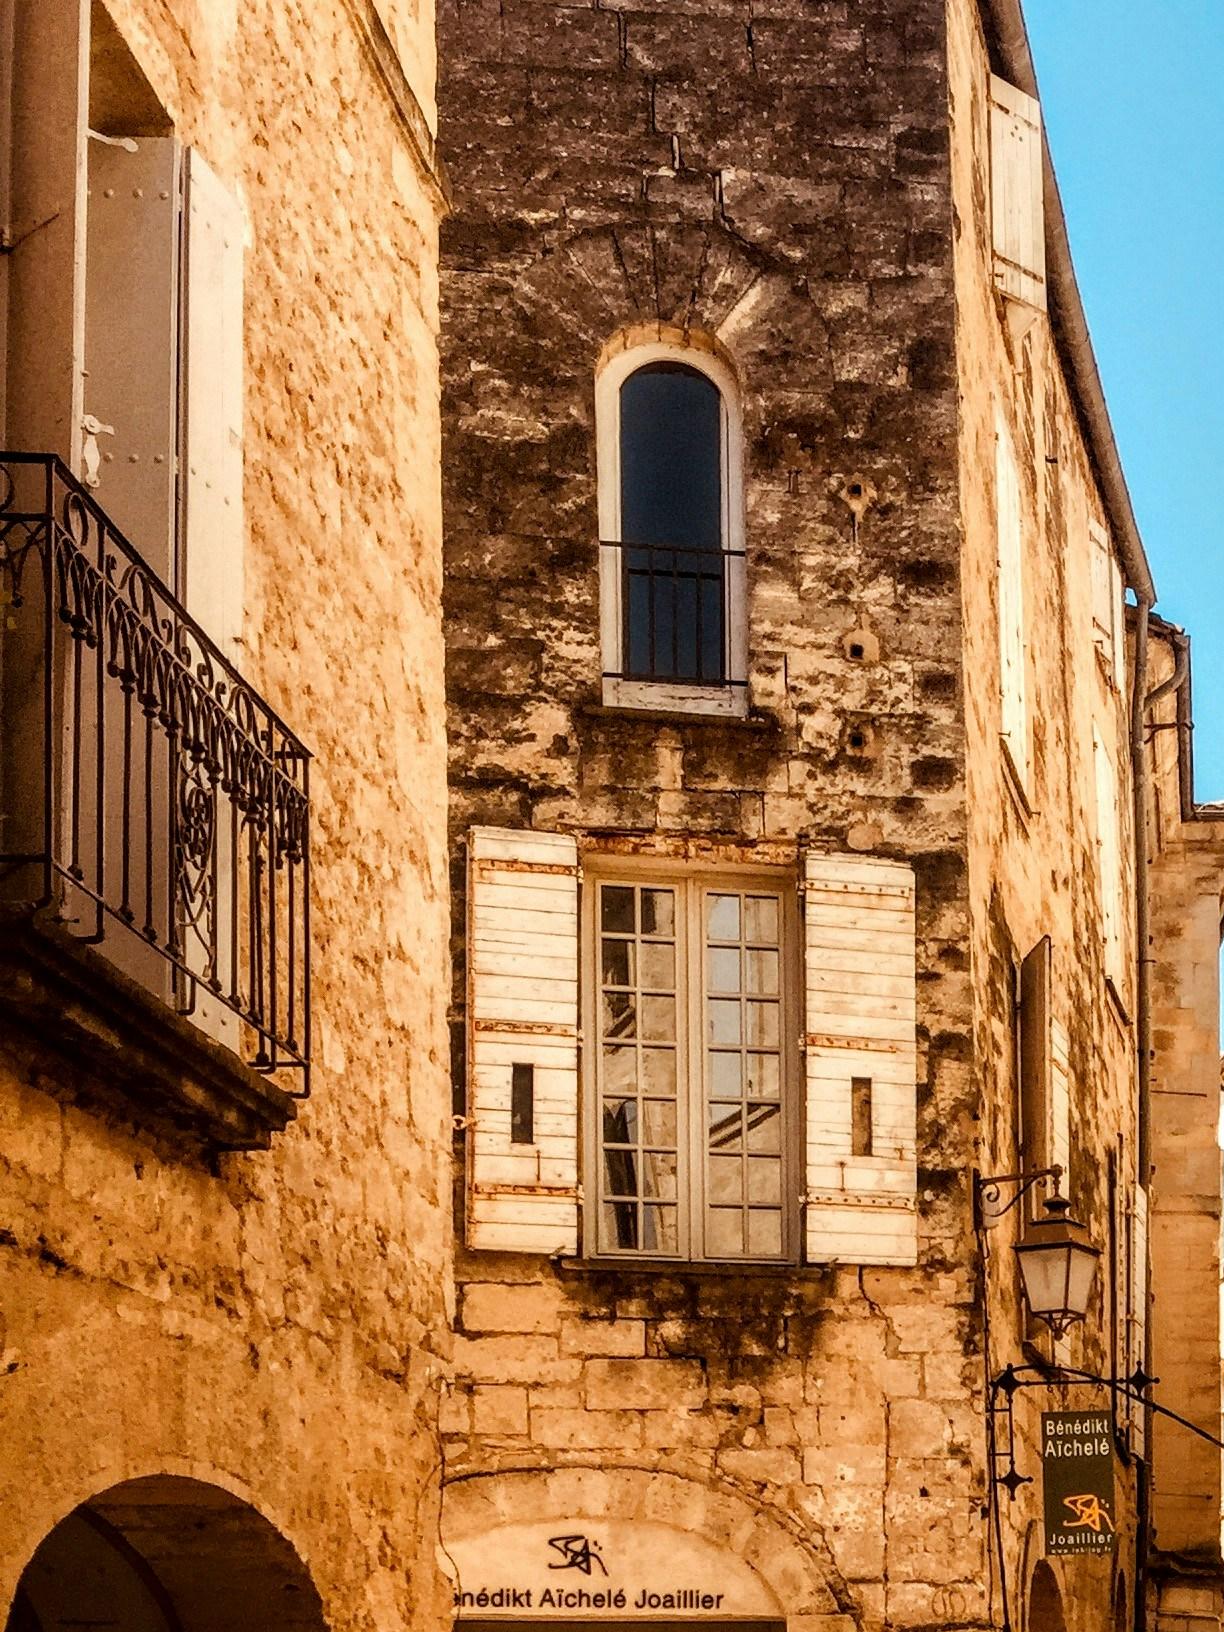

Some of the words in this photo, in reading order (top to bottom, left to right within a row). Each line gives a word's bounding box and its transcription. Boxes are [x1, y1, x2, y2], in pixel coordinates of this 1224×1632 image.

[1046, 1419, 1109, 1436] Bénédikt
[1044, 1437, 1110, 1458] Aïchelé
[1049, 1533, 1113, 1546] Joaillier
[538, 1588, 627, 1609] Aïchelé
[634, 1590, 724, 1610] Joaillier
